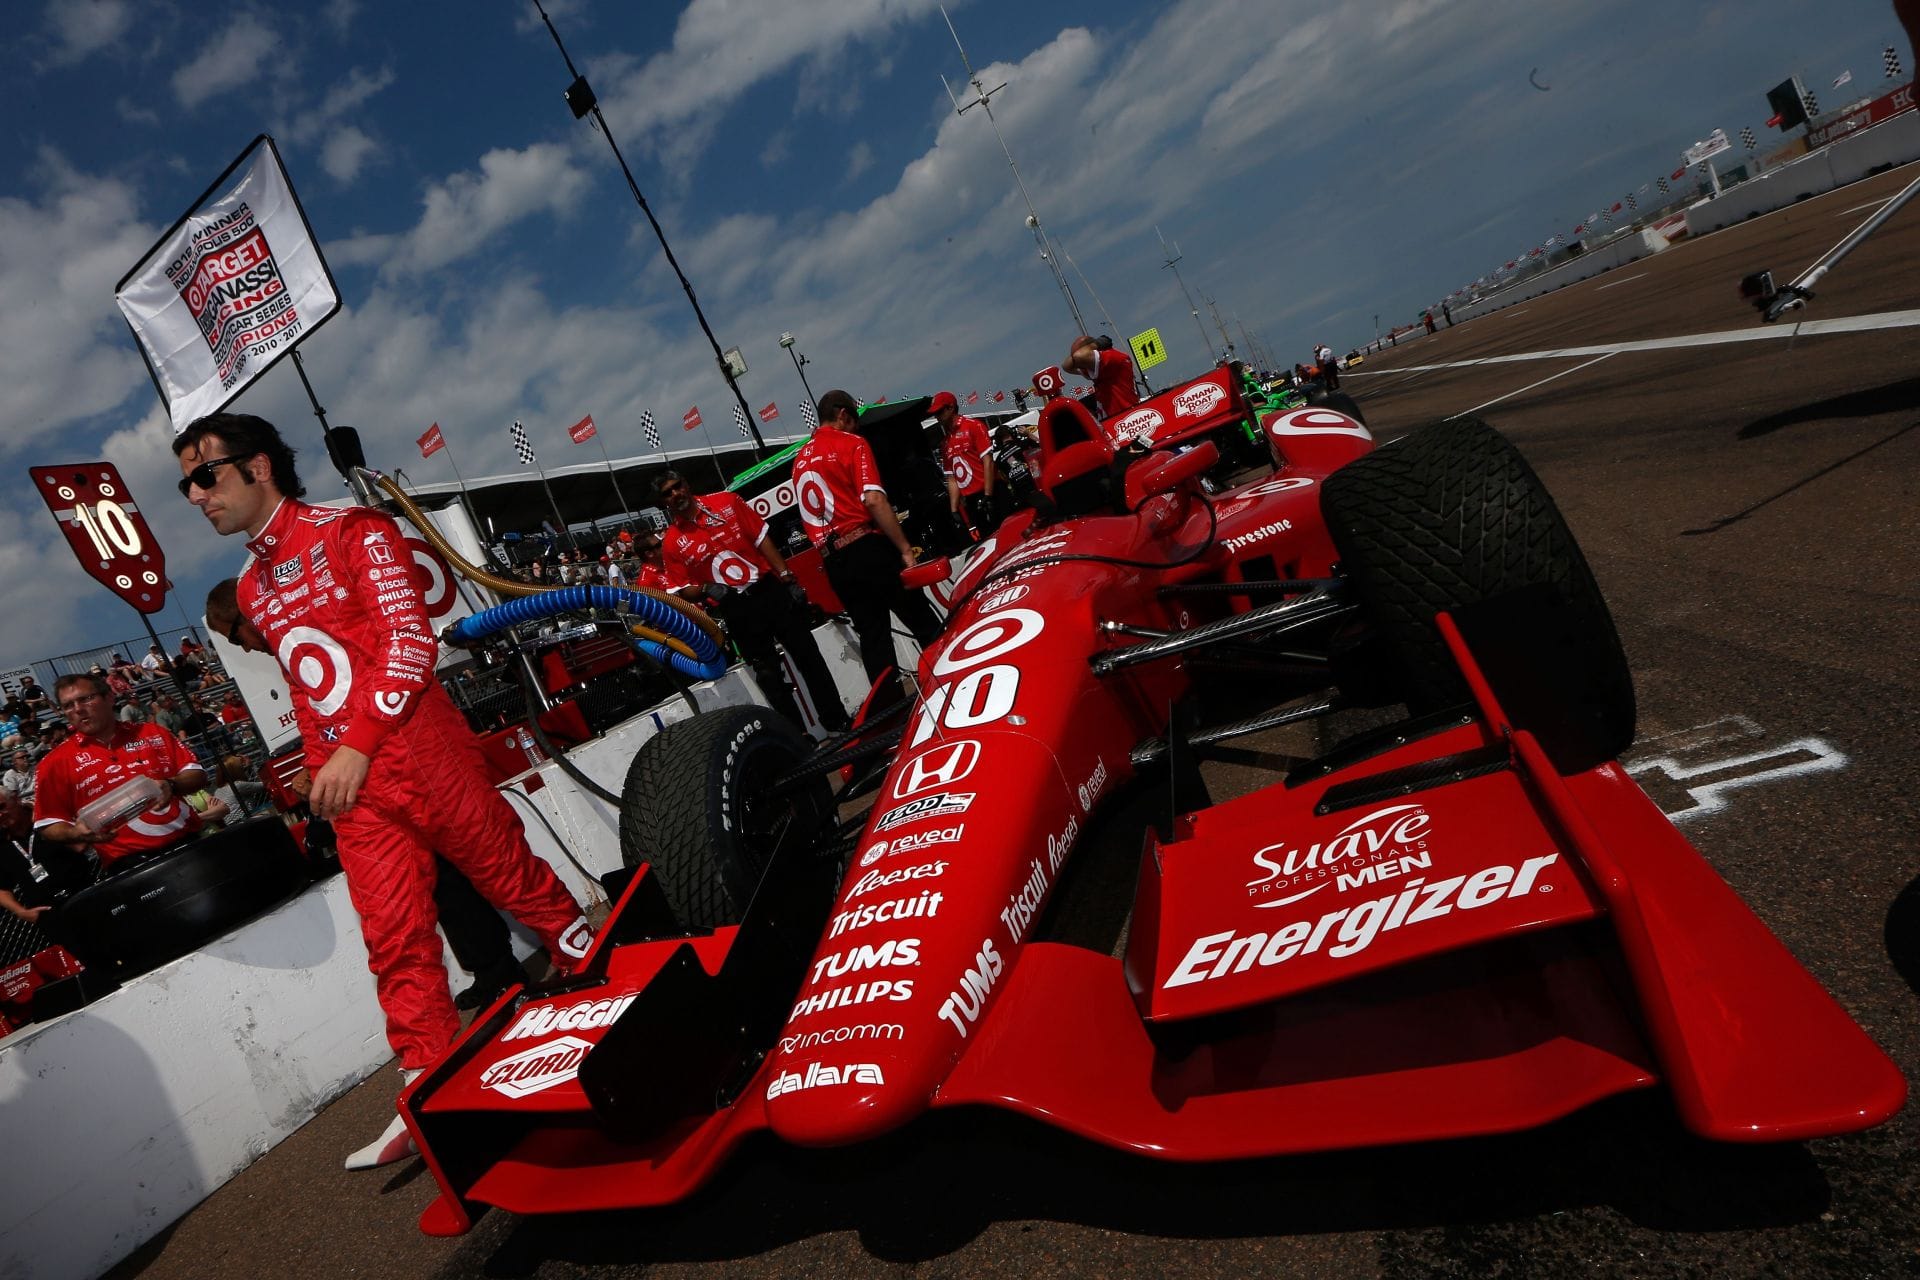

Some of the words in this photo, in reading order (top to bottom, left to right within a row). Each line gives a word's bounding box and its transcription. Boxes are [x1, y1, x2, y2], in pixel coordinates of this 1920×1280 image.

[165, 246, 192, 278] 2012
[191, 202, 249, 244] WINNER
[173, 232, 231, 290] INDIANAPOLIS
[232, 217, 255, 237] 500
[200, 235, 263, 297] TARGET
[208, 259, 276, 320] GANASSI
[255, 293, 292, 322] SERIES
[209, 280, 282, 346] RACING
[219, 307, 297, 379] CHAMPIONS
[251, 339, 278, 357] 2010
[283, 321, 303, 341] 2011
[1140, 340, 1156, 358] 11
[1177, 385, 1218, 408] BANANA
[1186, 395, 1213, 412] BOAT
[1117, 412, 1157, 433] BANANA
[1126, 421, 1152, 439] BOAT
[73, 500, 142, 560] 10
[1220, 519, 1293, 554] Firestone
[376, 577, 408, 592] Triscuit
[378, 589, 416, 605] PHILIPS
[381, 601, 416, 616] Lexar
[388, 662, 424, 674] Microsoft
[910, 664, 1020, 750] 10
[721, 719, 762, 833] Firestone
[1086, 755, 1107, 799] reveal
[881, 797, 939, 826] IZOD
[889, 824, 965, 853] reveal
[1048, 813, 1079, 876] Reese's
[1245, 811, 1432, 888] Suave
[844, 860, 949, 903] Reese's
[1248, 840, 1428, 897] PROFESSIONALS
[1337, 851, 1432, 893] MEN
[829, 890, 944, 940] Triscuit
[1000, 860, 1048, 944] Triscuit
[1163, 852, 1559, 989] Energizer
[810, 938, 921, 985] TUMS
[788, 979, 914, 1024] PHILIPS
[938, 938, 1002, 1039] TUMS
[800, 1023, 904, 1049] incomm
[767, 1061, 885, 1101] dallara
